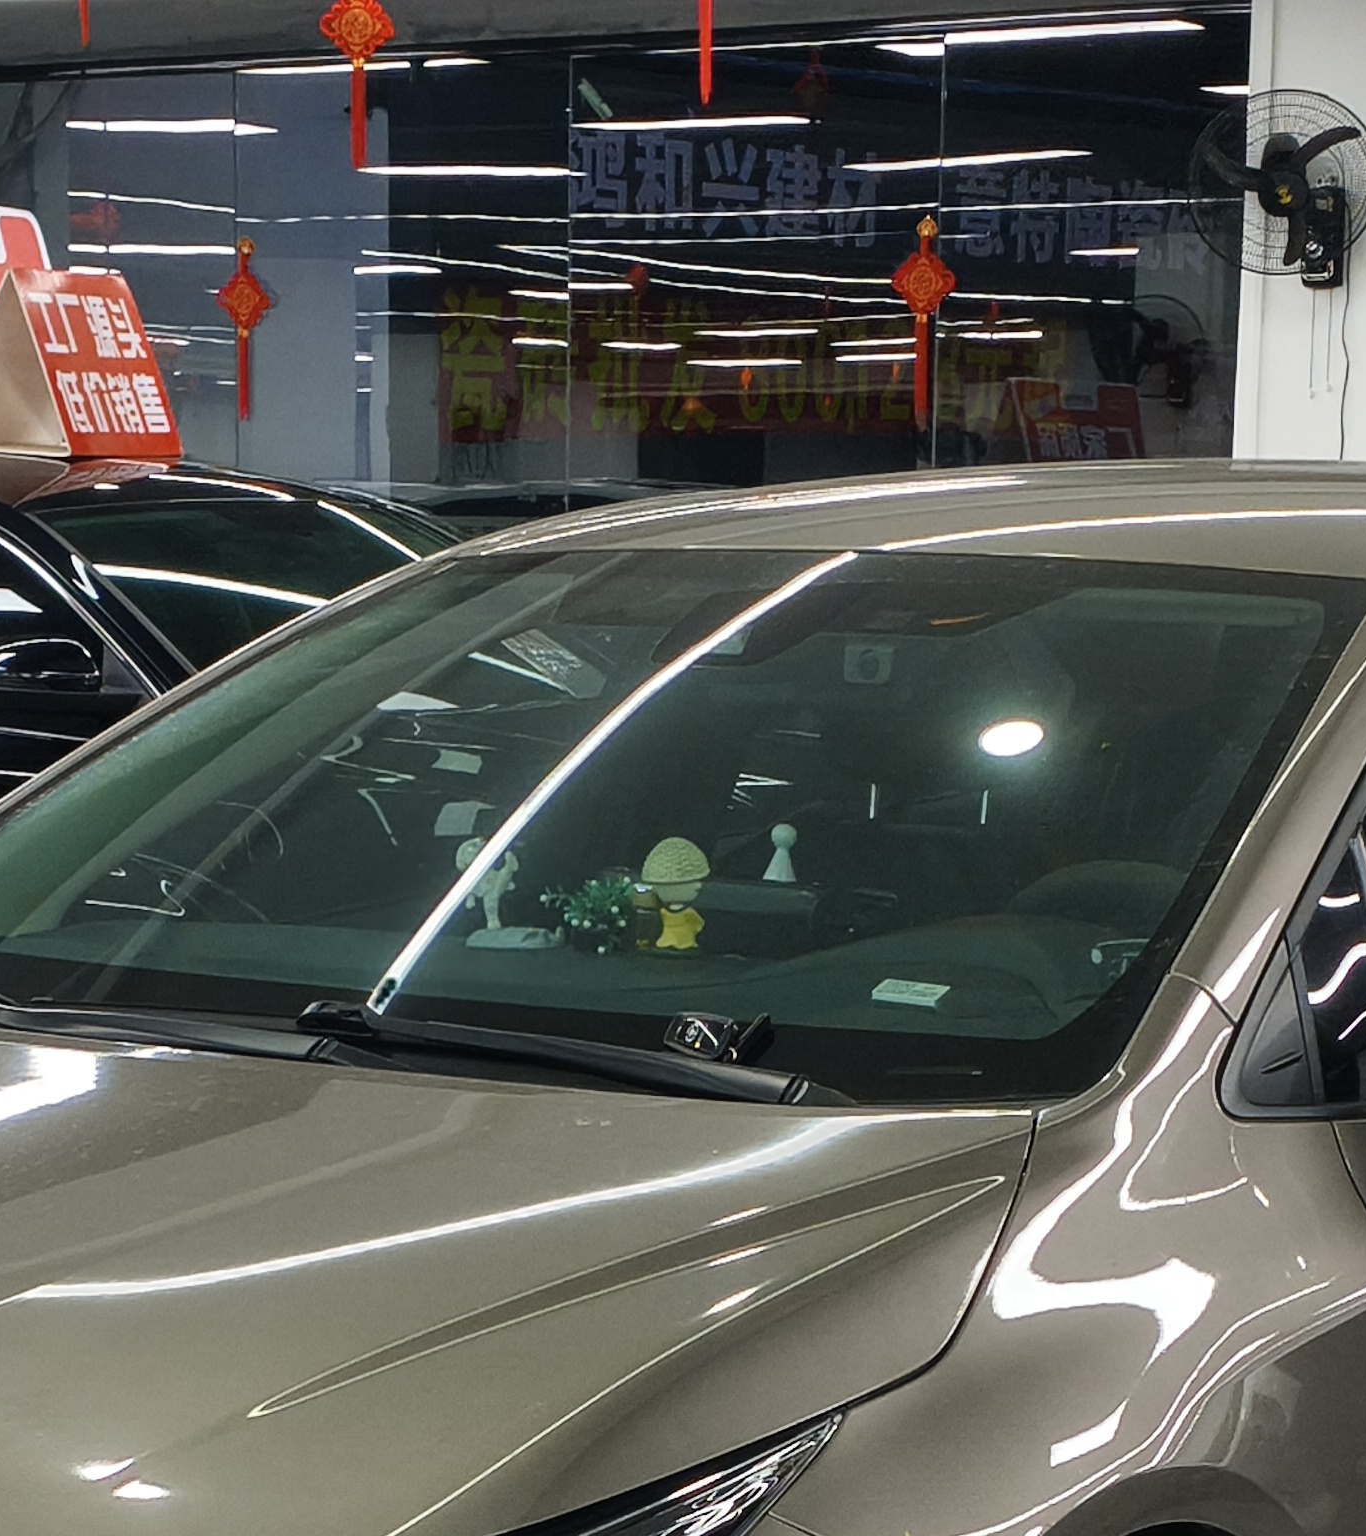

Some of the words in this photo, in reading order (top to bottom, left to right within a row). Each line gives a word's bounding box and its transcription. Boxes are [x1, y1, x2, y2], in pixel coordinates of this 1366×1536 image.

[26, 292, 148, 358] 工厂源头
[55, 369, 171, 434] 低价销售
